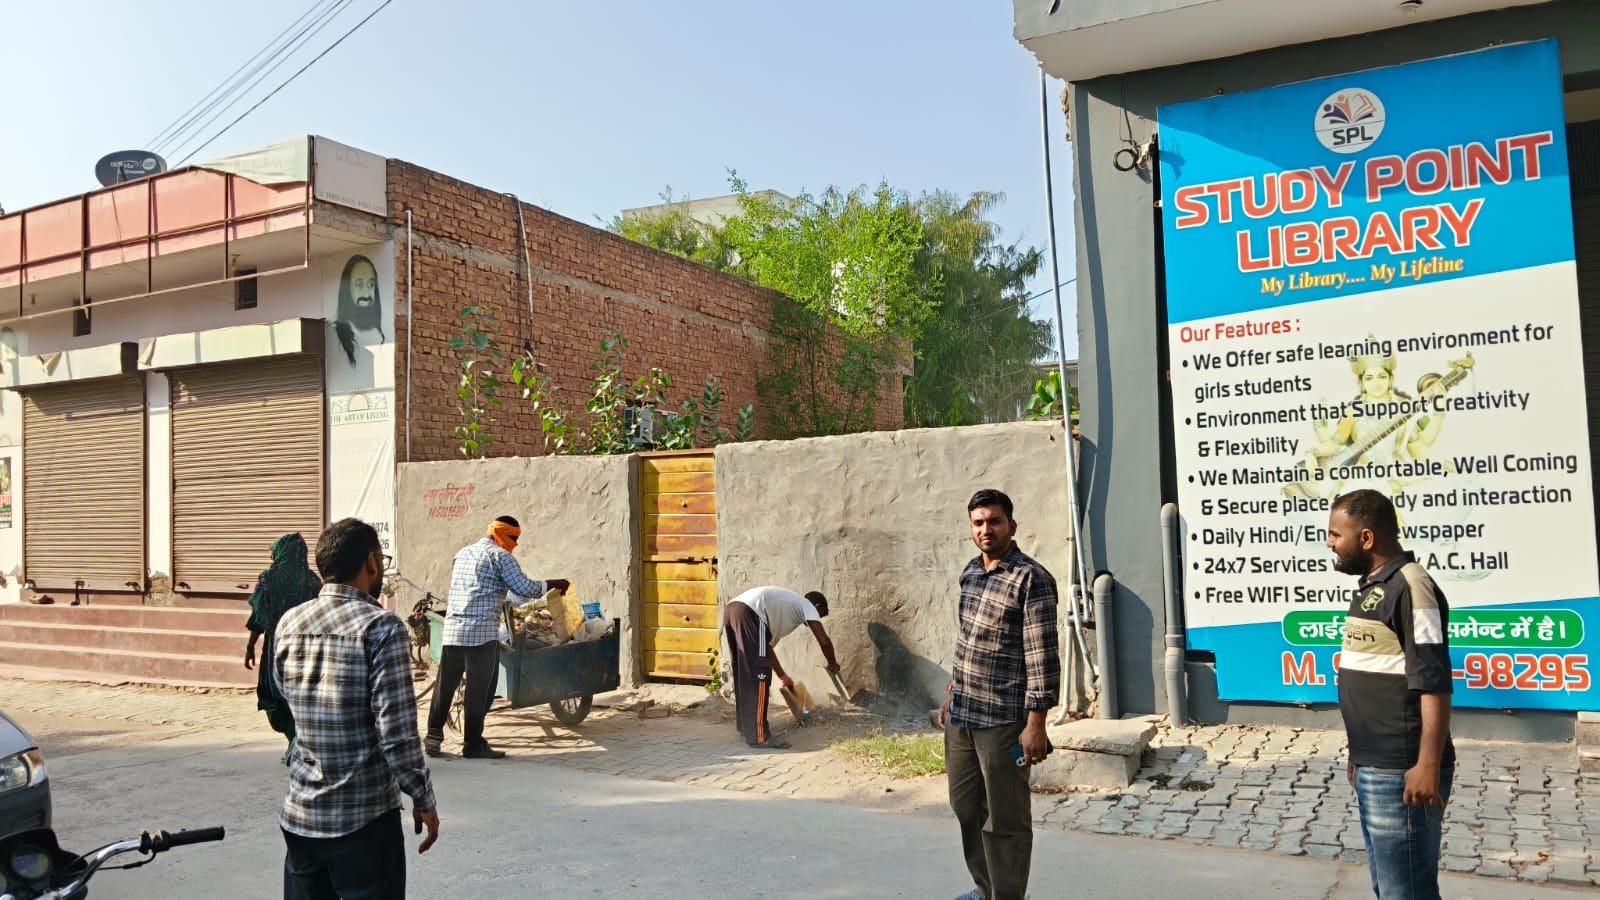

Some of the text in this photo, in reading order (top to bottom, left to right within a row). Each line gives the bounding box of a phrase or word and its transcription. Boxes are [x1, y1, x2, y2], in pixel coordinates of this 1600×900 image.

[1333, 126, 1373, 146] SPL
[1174, 131, 1553, 229] STUDY POINT
[1236, 198, 1486, 273] LIBRARY
[1260, 275, 1284, 297] My
[1370, 264, 1396, 282] My
[1400, 257, 1464, 280] Lifeline
[1181, 327, 1210, 343] Our
[1215, 320, 1291, 340] Features
[1193, 323, 1554, 371] We Offer safe learning environment for
[1195, 375, 1312, 404] girls students
[366, 411, 389, 420] LIVING
[1196, 390, 1530, 429] Environment that Support Creativity
[1198, 436, 1299, 458] & Flexibility
[1198, 452, 1578, 487] We Maintain a comfortable, Well Coming
[1201, 499, 1214, 516] &
[1217, 498, 1278, 515] Secure
[1282, 495, 1329, 516] place
[1422, 488, 1458, 508] and
[1462, 485, 1572, 506] interaction
[1202, 523, 1485, 548] Daily Hindi/En wspaper
[1204, 557, 1246, 574] 24x7
[1250, 555, 1328, 574] Services
[1426, 552, 1465, 570] A.C.
[1470, 551, 1509, 570] Hall
[1206, 585, 1353, 603] Free WIFI Servic
[1509, 615, 1534, 638] में
[1281, 651, 1326, 686] M.
